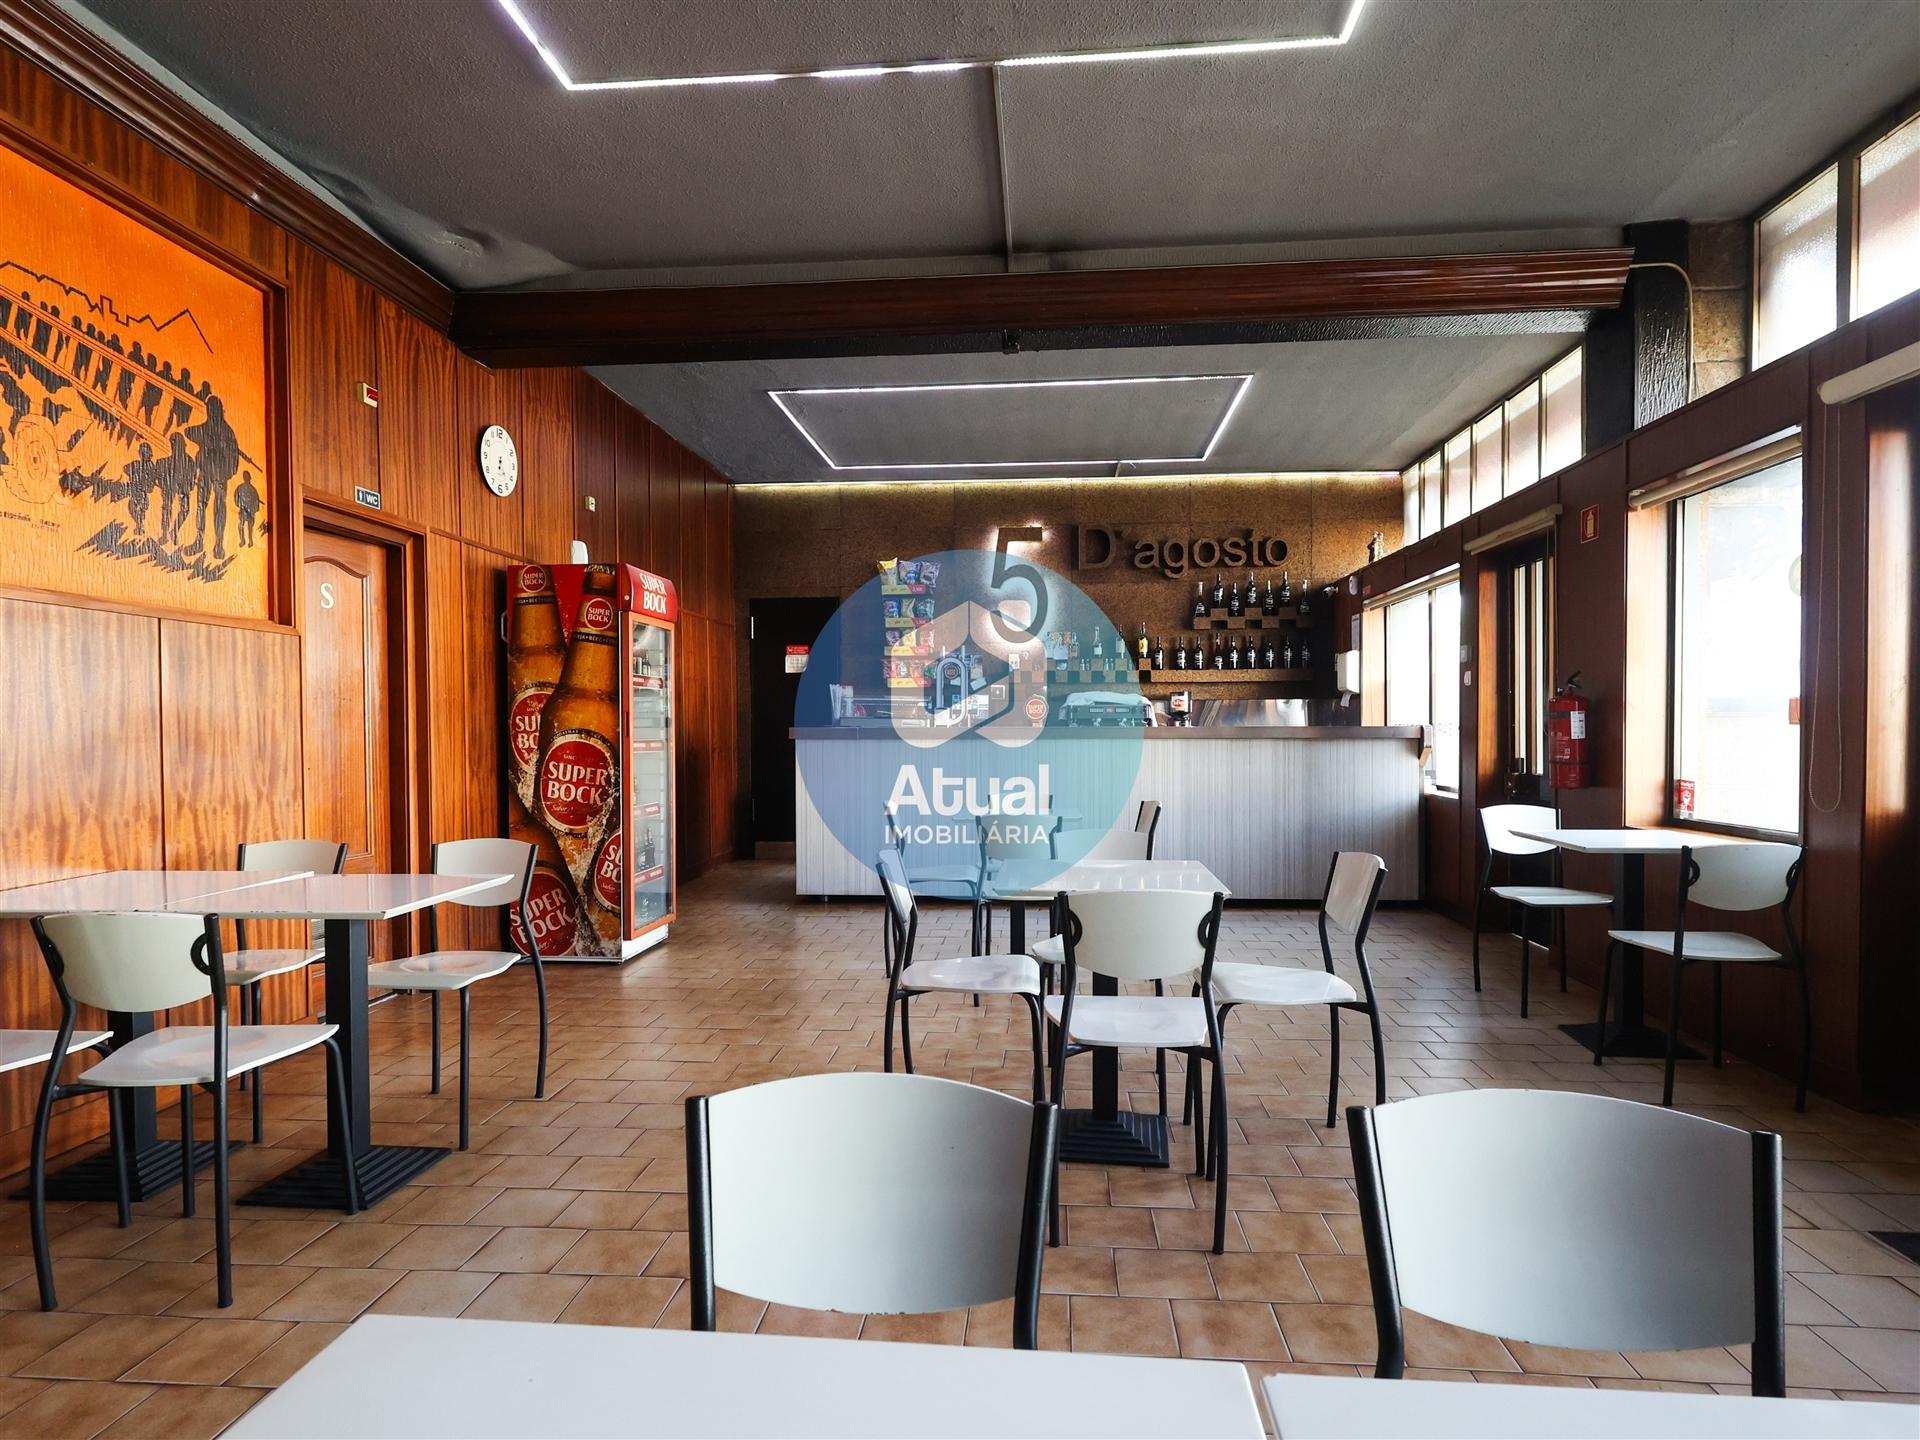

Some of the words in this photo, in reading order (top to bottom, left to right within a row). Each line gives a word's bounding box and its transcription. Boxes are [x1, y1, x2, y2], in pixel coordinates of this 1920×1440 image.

[496, 428, 503, 439] 12
[366, 494, 378, 505] WC
[498, 485, 503, 493] 6
[320, 582, 334, 608] S
[640, 573, 667, 596] SUPER
[990, 526, 1048, 643] 5
[1077, 525, 1289, 578] D'agosto
[588, 606, 610, 616] SUPER
[643, 590, 667, 614] BOCK
[587, 614, 609, 623] BOCK
[548, 761, 609, 786] SUPER
[547, 780, 606, 805] BOCK
